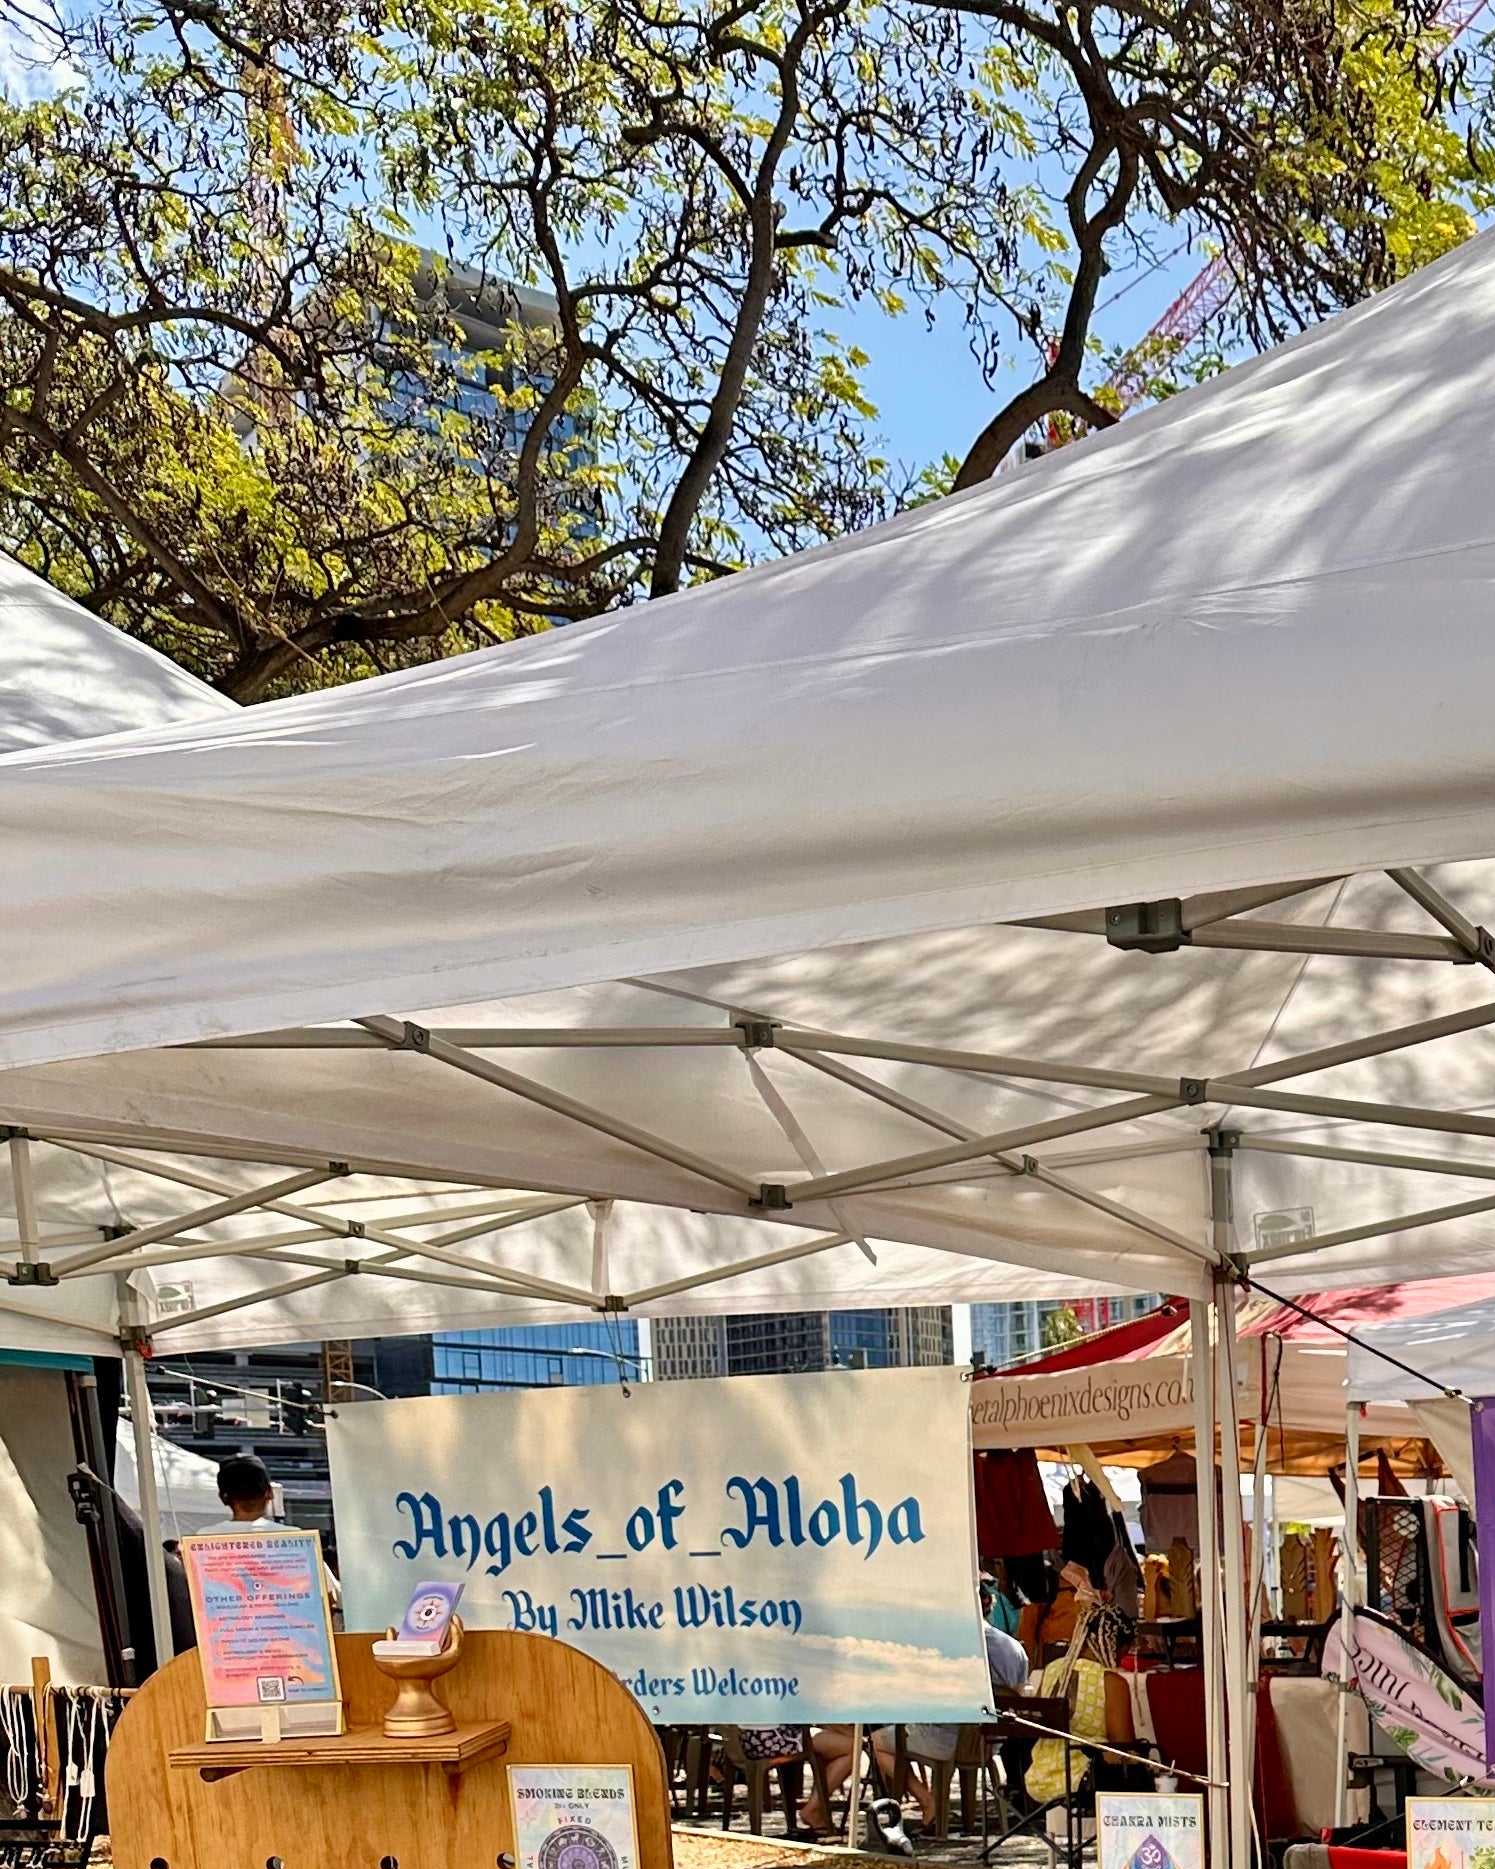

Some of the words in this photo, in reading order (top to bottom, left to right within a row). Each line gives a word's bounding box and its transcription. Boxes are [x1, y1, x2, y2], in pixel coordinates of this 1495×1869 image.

[190, 1540, 263, 1551] ENLIGHTENED
[267, 1539, 312, 1548] REALITY
[205, 1595, 243, 1603] OTHER
[247, 1592, 311, 1602] OFFERINGS
[503, 1590, 557, 1637] By
[568, 1588, 665, 1631] Mike
[674, 1583, 802, 1635] Wilson
[614, 1667, 685, 1698] rders
[692, 1667, 799, 1700] Welcome
[517, 1788, 573, 1799] SMOKING
[577, 1788, 625, 1799] BLENDS
[557, 1816, 592, 1825] FIXED
[1103, 1816, 1153, 1828] CHAKRA
[1158, 1816, 1197, 1828] MISTS
[1413, 1819, 1472, 1831] ELEMENT
